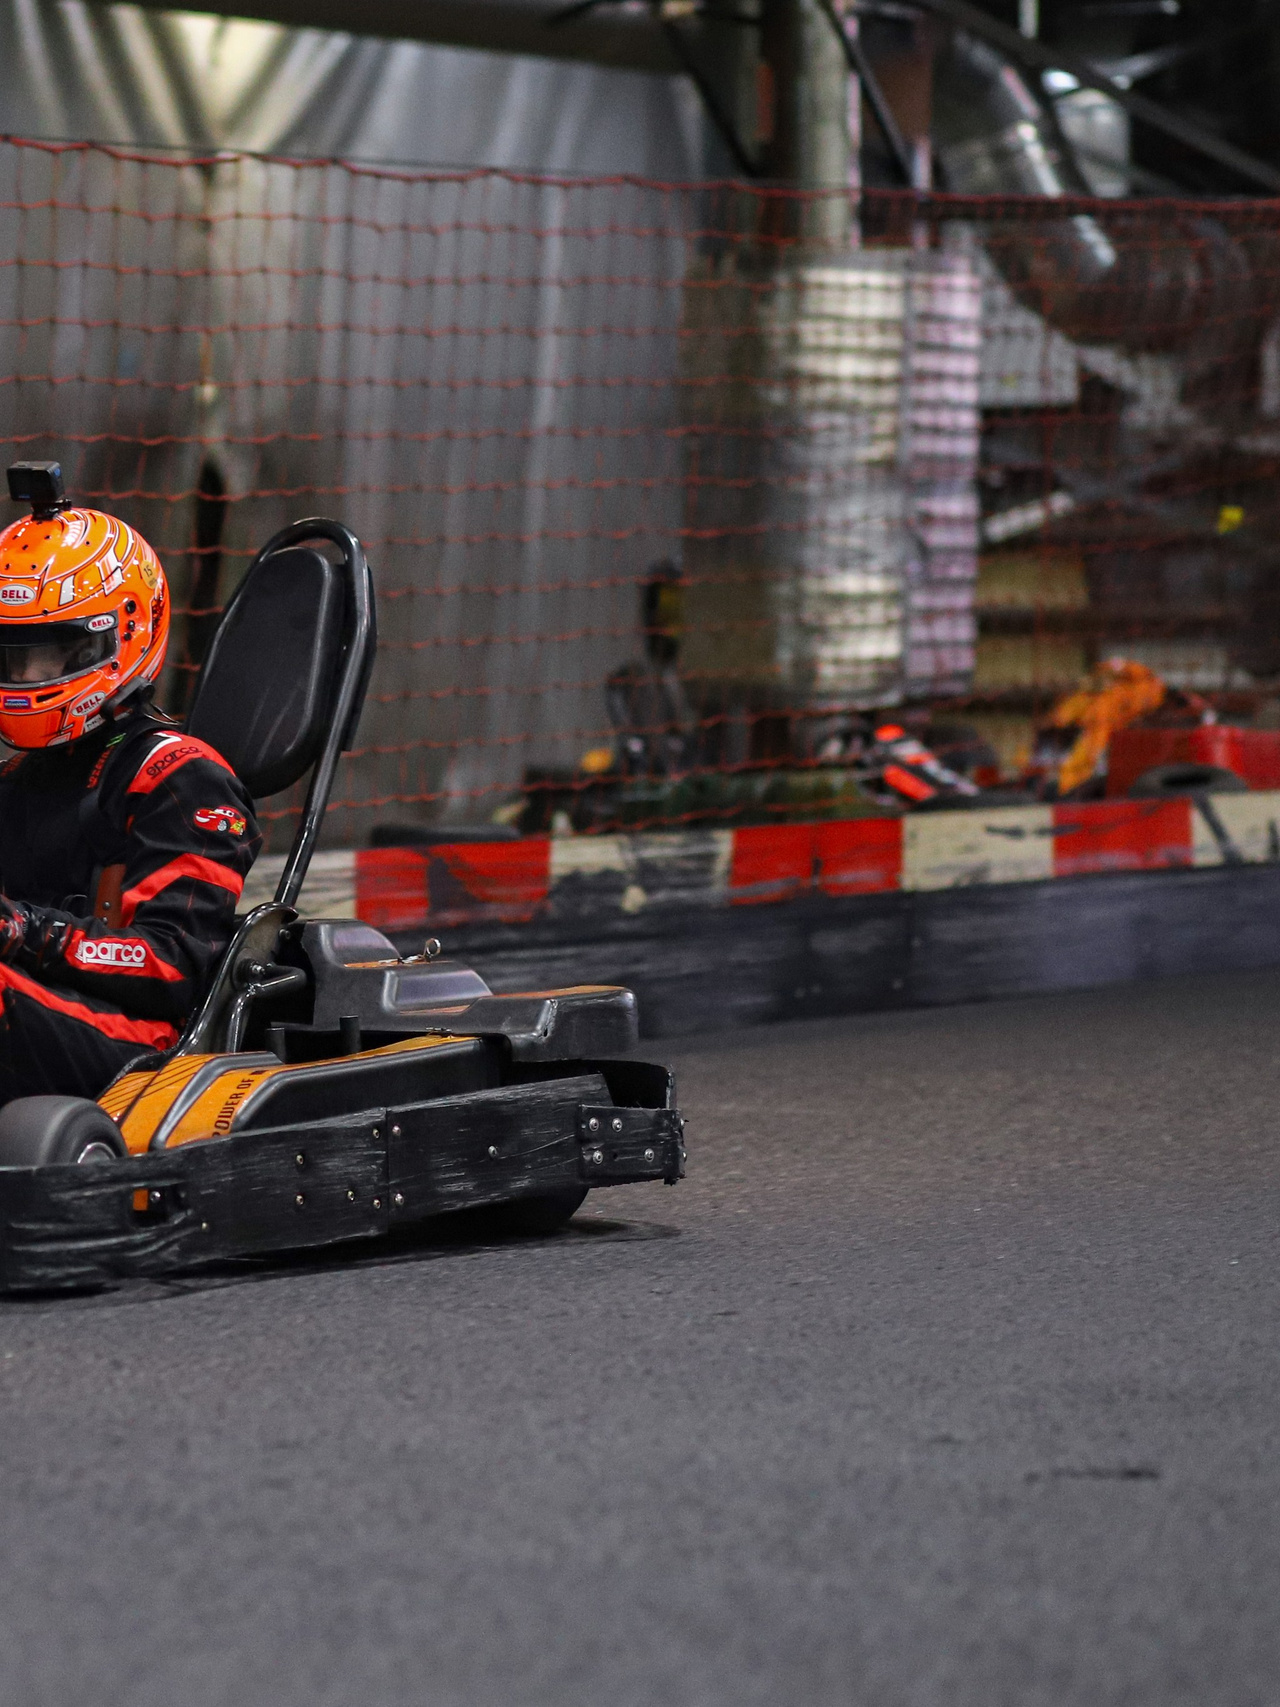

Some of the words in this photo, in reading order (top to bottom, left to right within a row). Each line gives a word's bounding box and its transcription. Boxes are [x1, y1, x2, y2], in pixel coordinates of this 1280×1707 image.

[143, 564, 153, 577] 15
[1, 589, 30, 599] BELL
[91, 618, 111, 628] BELL
[75, 695, 101, 713] BELL
[146, 746, 202, 780] sparco
[236, 1078, 255, 1090] OF
